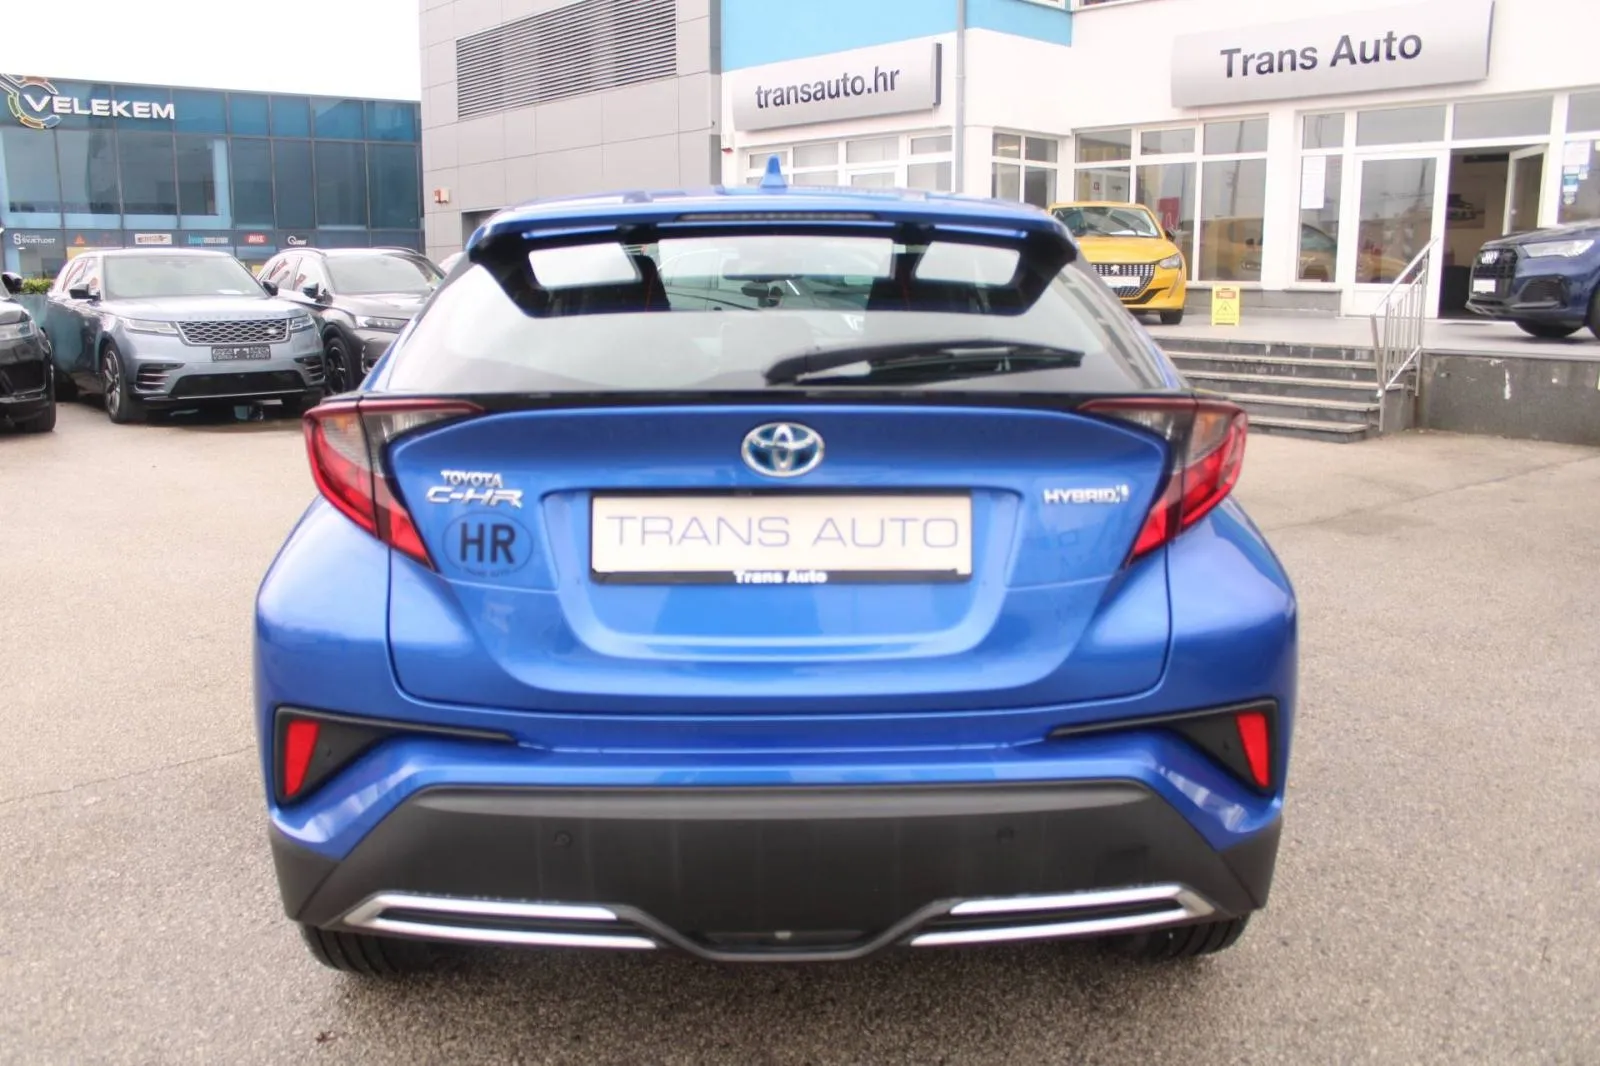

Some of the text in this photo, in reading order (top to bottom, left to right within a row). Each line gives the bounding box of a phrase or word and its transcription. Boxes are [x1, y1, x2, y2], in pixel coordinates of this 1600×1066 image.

[1220, 30, 1423, 79] Trans Auto
[755, 66, 901, 110] transauto.hr
[23, 93, 175, 120] VELEKEM
[440, 469, 504, 488] TOYOTA
[426, 485, 524, 509] C-HR
[1043, 487, 1117, 504] HYBRID
[460, 521, 517, 565] HR
[606, 515, 960, 548] TRANS AUTO
[732, 568, 828, 584] Trans Auto
